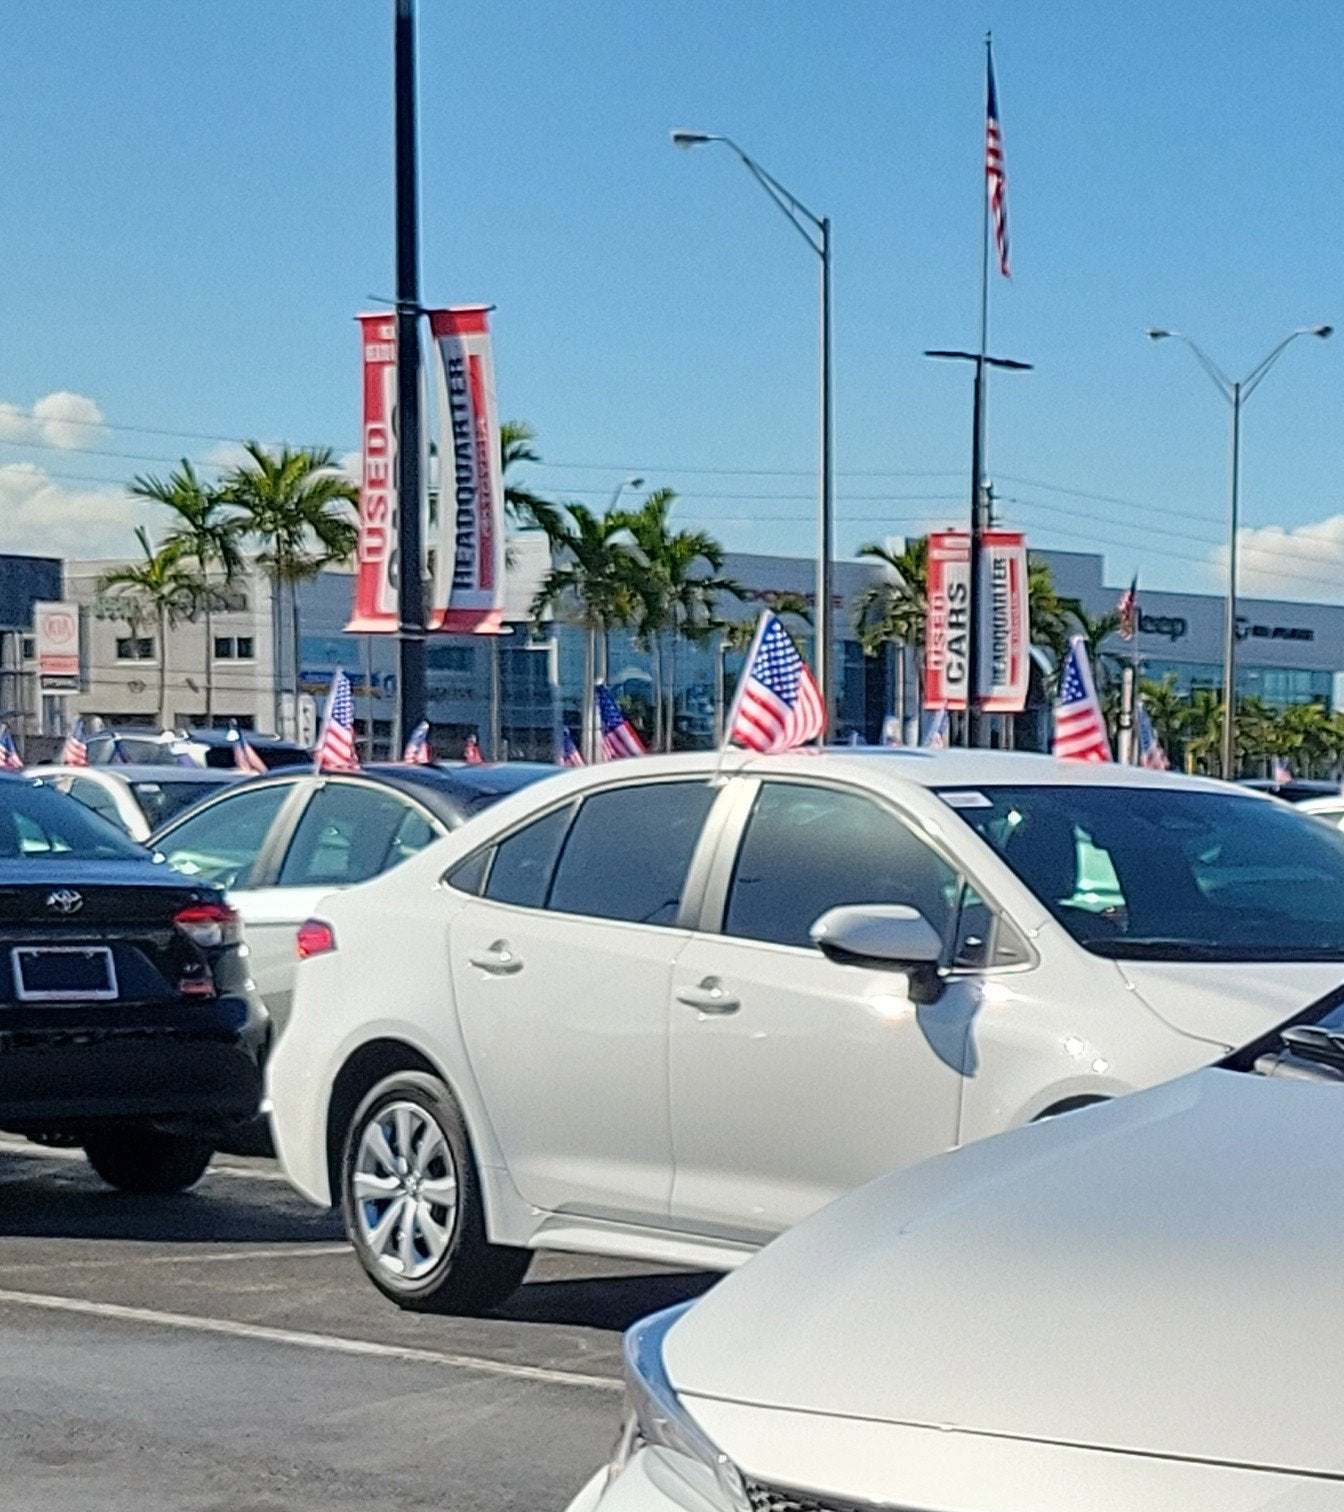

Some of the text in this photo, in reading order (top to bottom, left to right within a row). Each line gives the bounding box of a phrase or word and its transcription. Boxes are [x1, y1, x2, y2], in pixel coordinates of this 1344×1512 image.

[361, 423, 388, 563] USED
[448, 356, 477, 590] HEADQUARTER
[932, 595, 944, 669] USED
[947, 582, 967, 684] CARS
[992, 558, 1009, 686] HEADQUARTER
